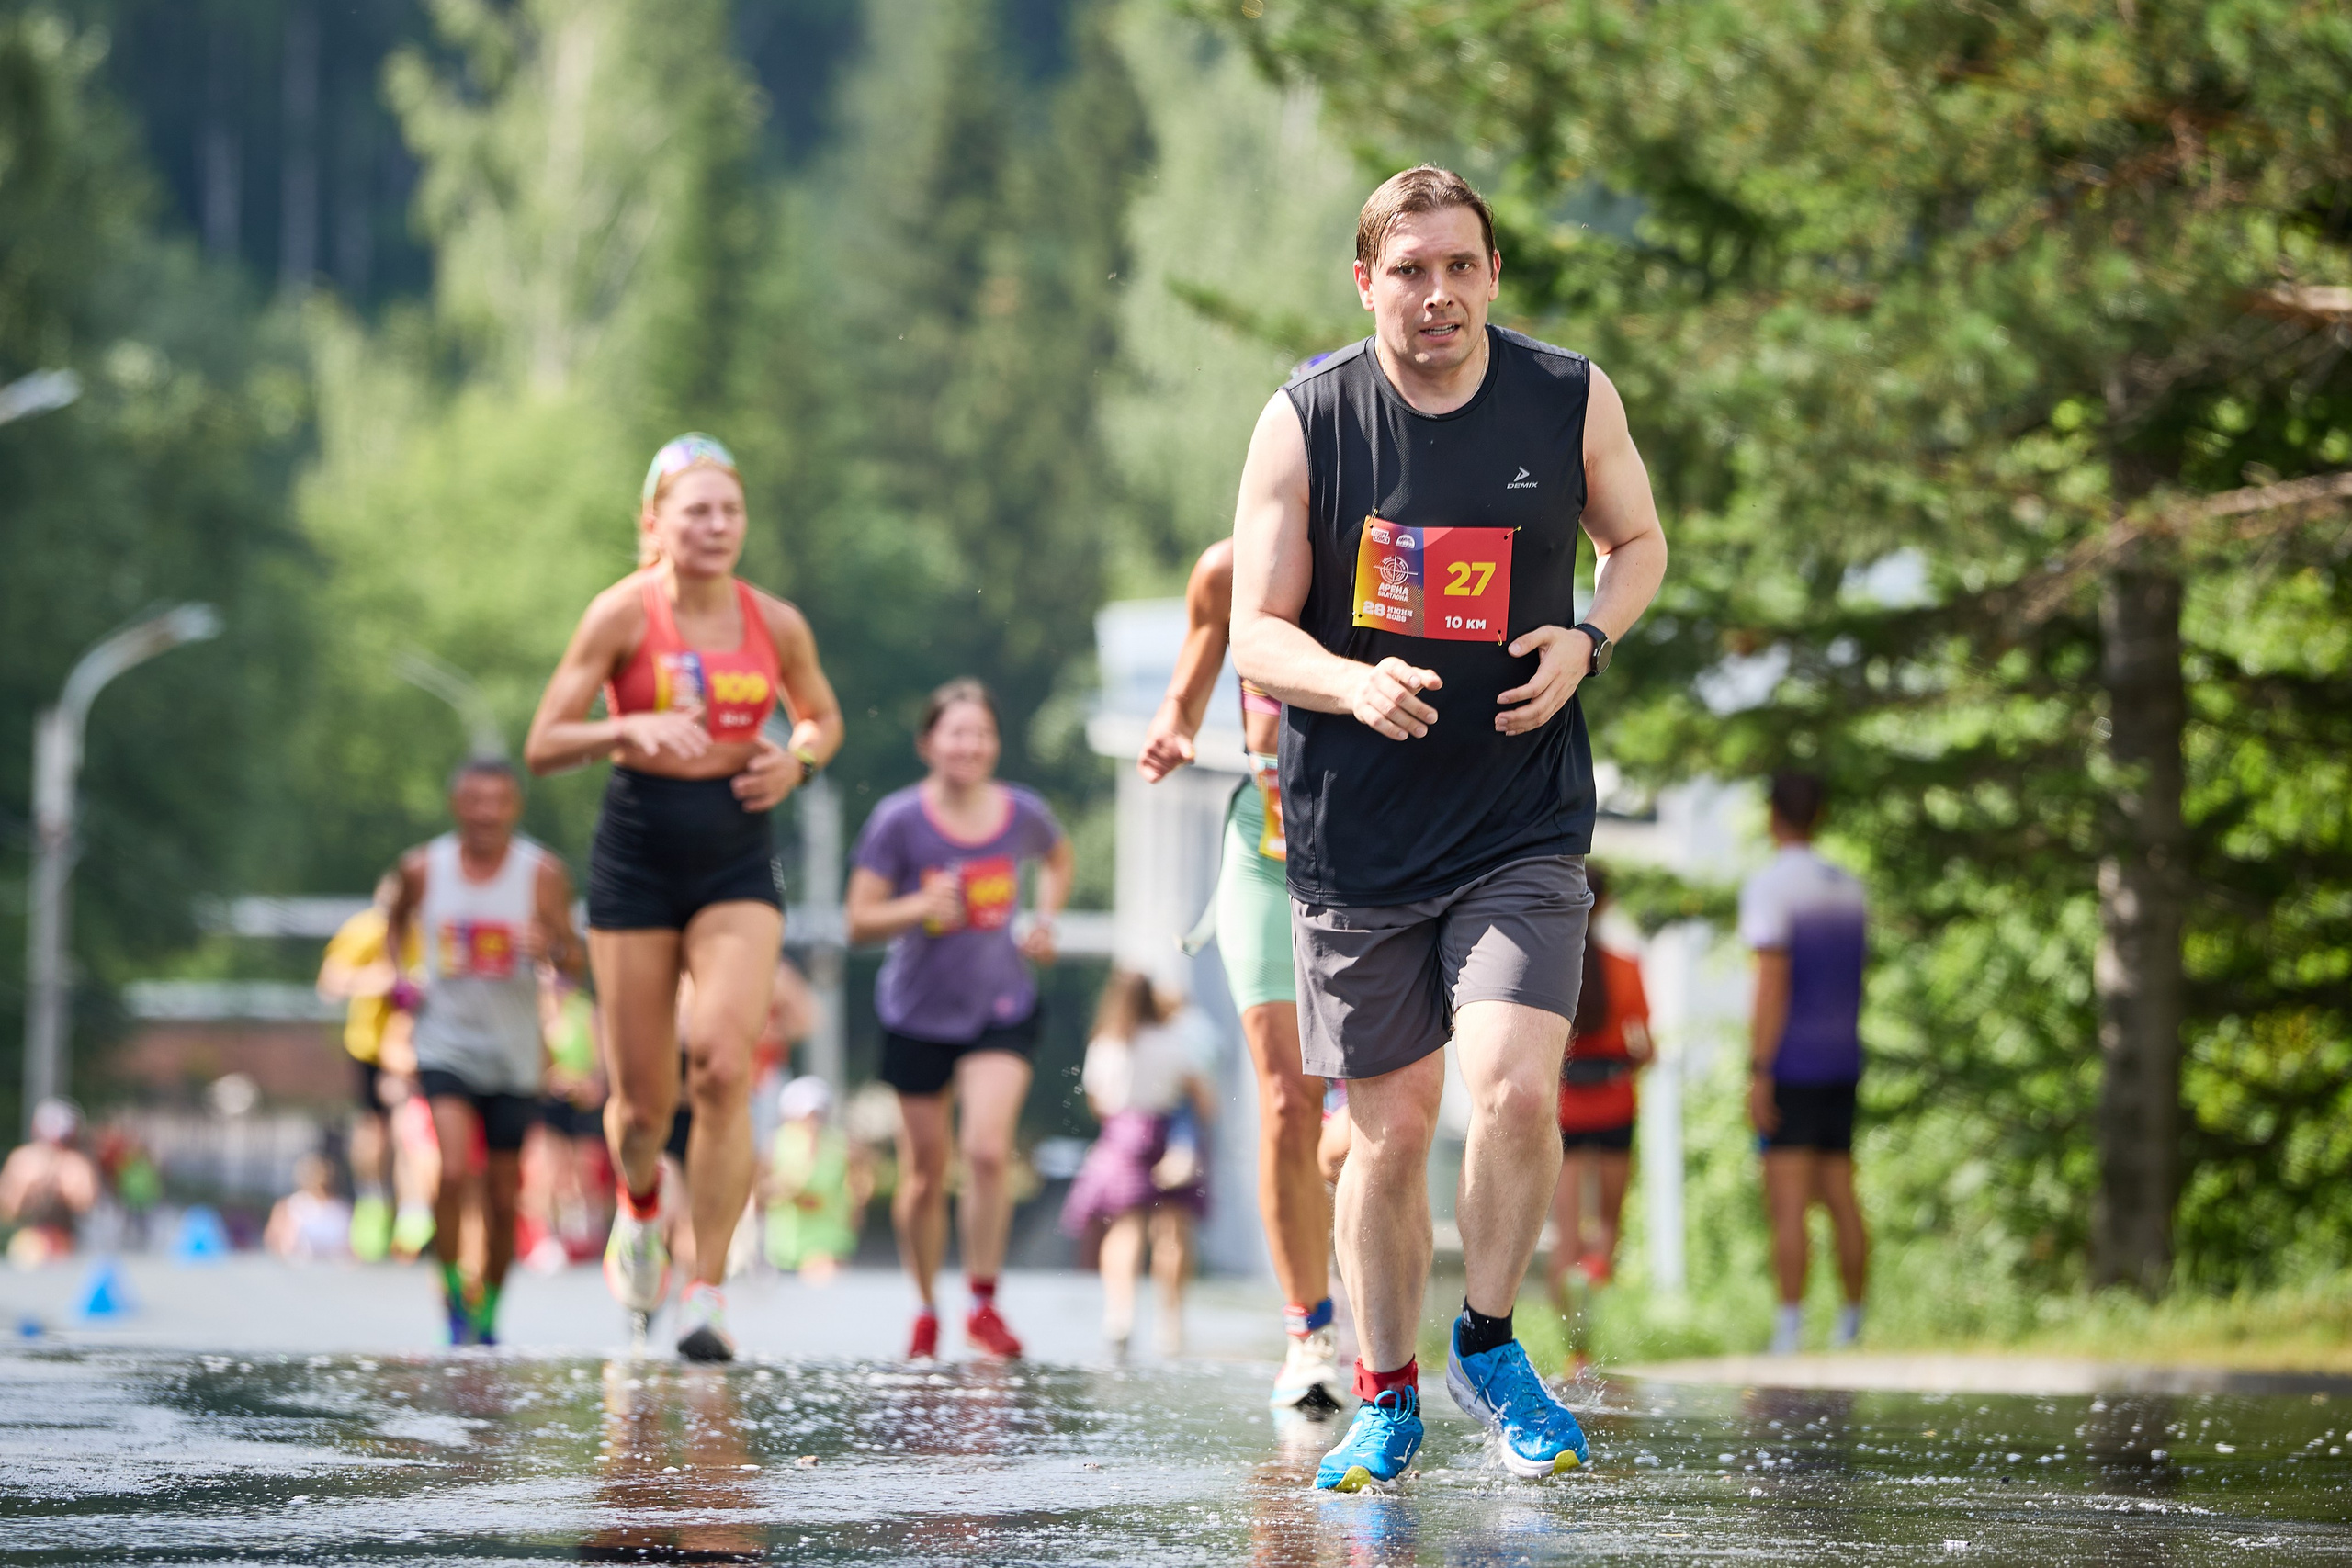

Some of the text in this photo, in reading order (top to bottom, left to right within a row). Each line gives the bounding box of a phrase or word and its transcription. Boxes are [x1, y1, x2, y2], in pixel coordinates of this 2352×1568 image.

[1443, 561, 1497, 597] 27
[1377, 590, 1408, 603] БИАТЛОНА
[1378, 582, 1408, 597] АРЕНА
[1363, 600, 1386, 617] 28
[1444, 615, 1463, 629] 10
